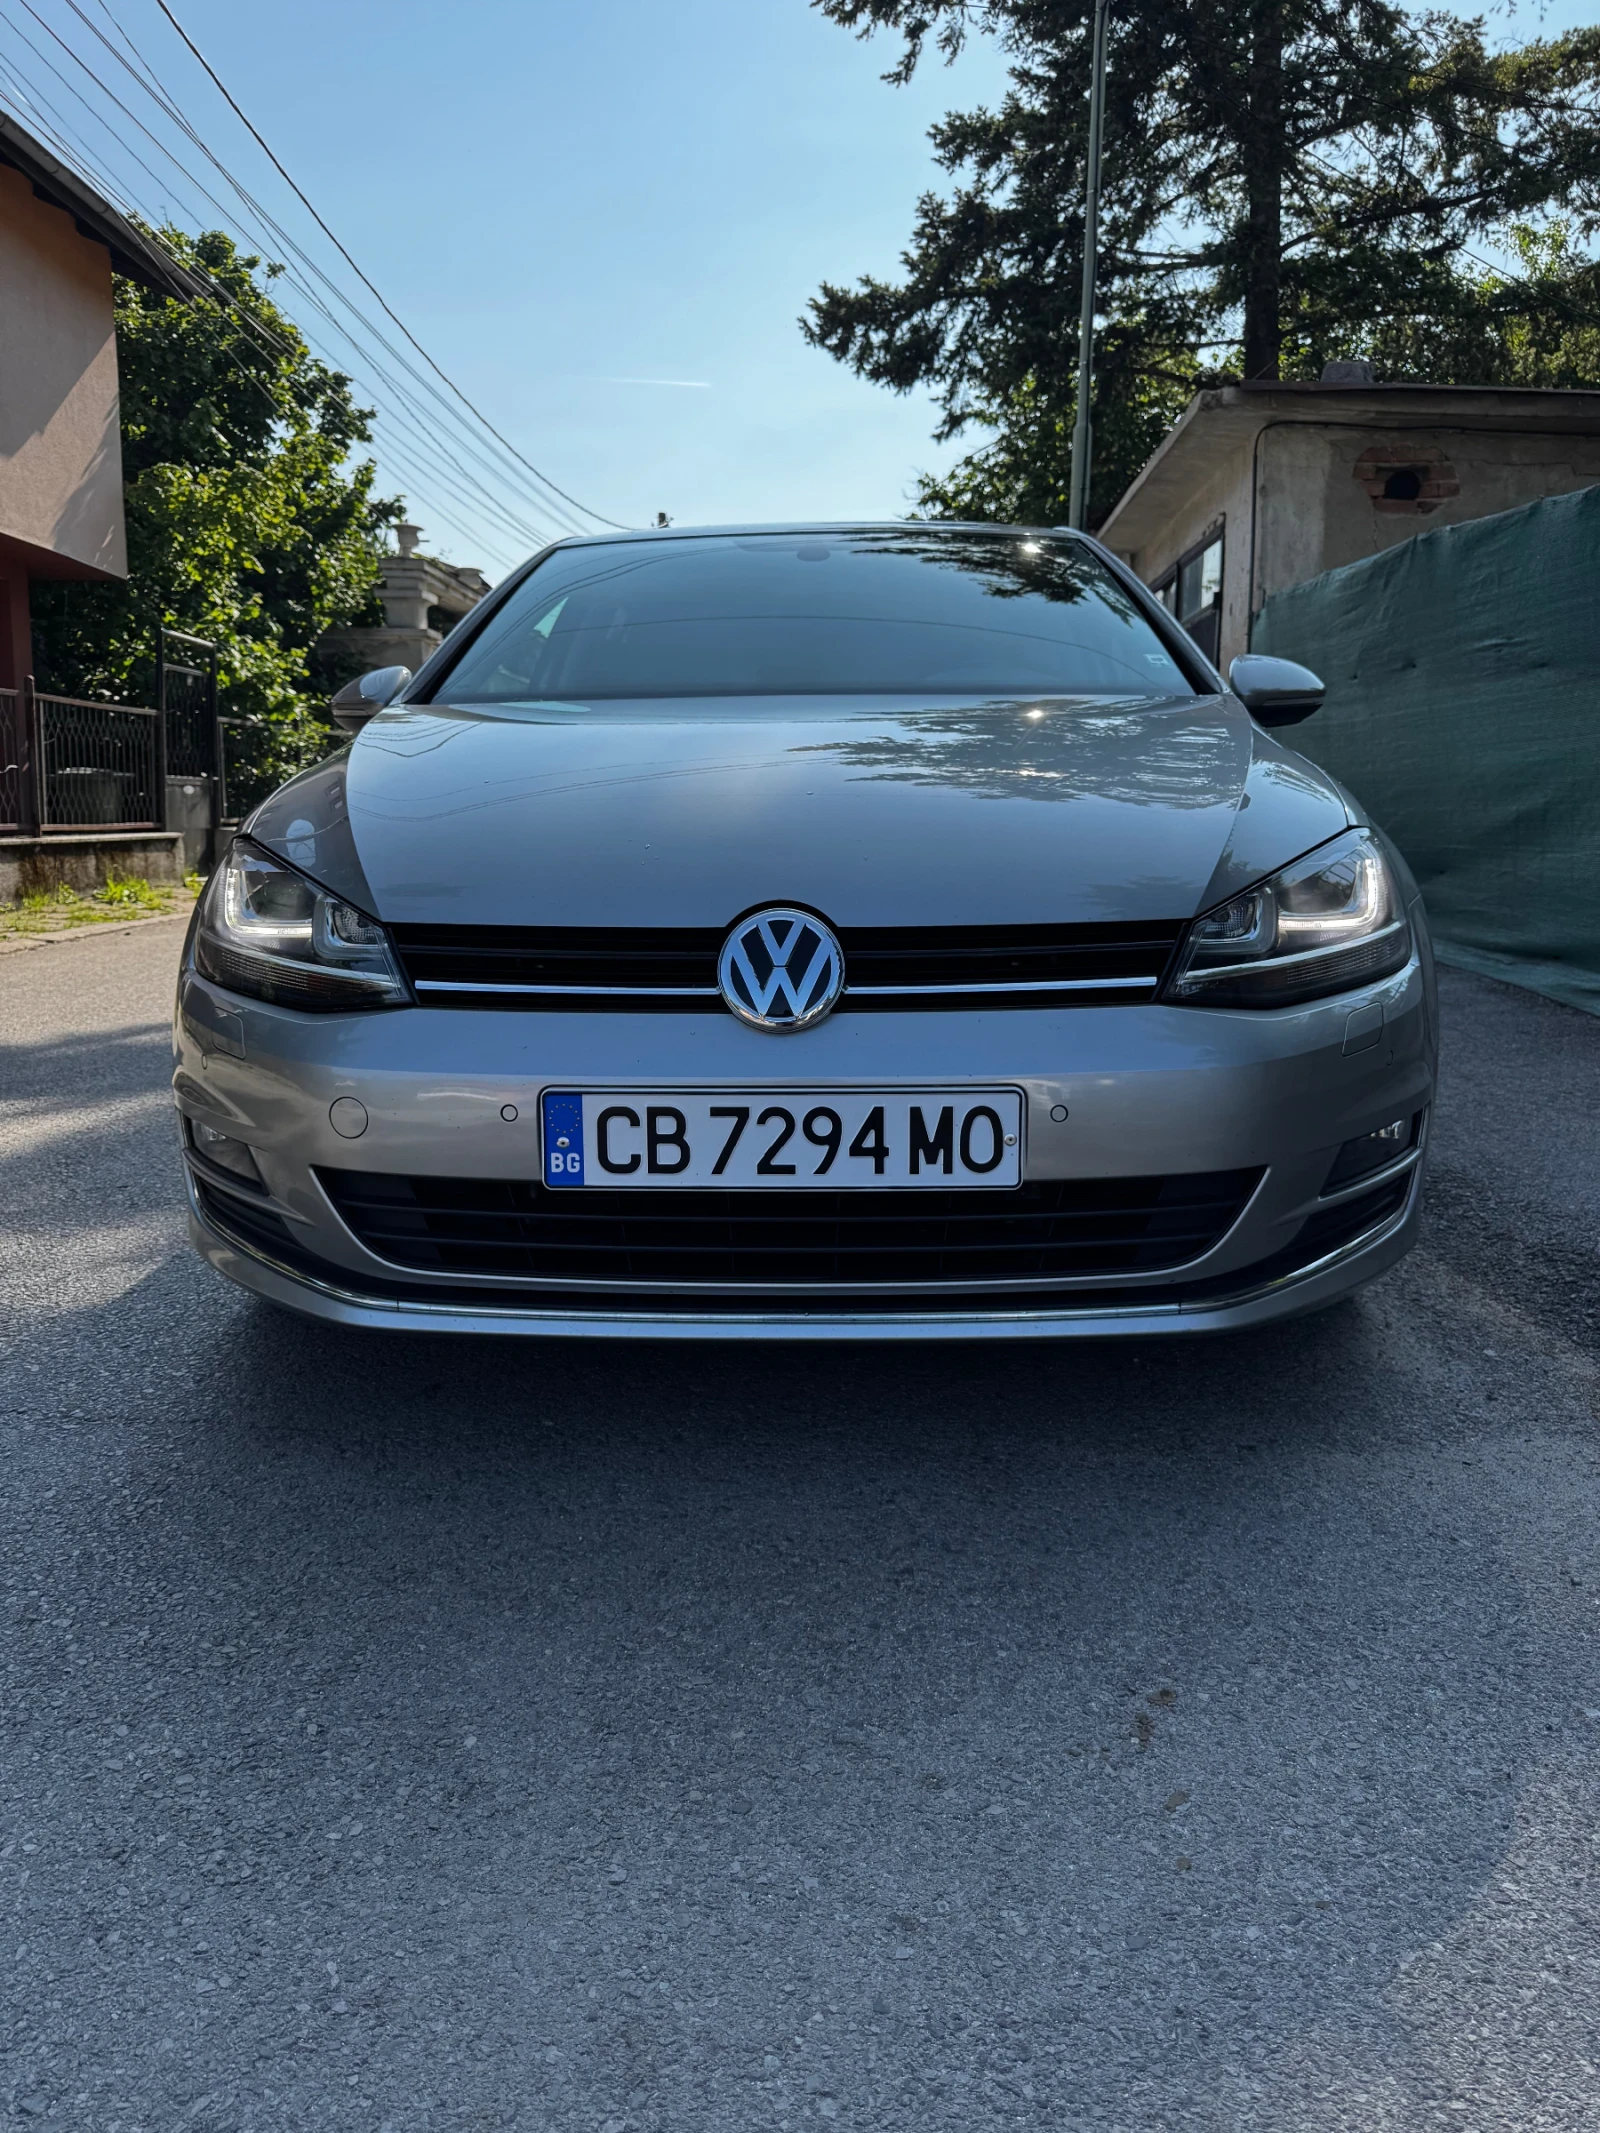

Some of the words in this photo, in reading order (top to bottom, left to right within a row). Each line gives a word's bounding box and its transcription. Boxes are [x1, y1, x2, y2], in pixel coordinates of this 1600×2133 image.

[724, 911, 837, 1025] VW
[550, 1152, 581, 1173] BG
[596, 1105, 691, 1174] CB
[709, 1105, 890, 1175] 7294
[908, 1105, 1004, 1175] MO
